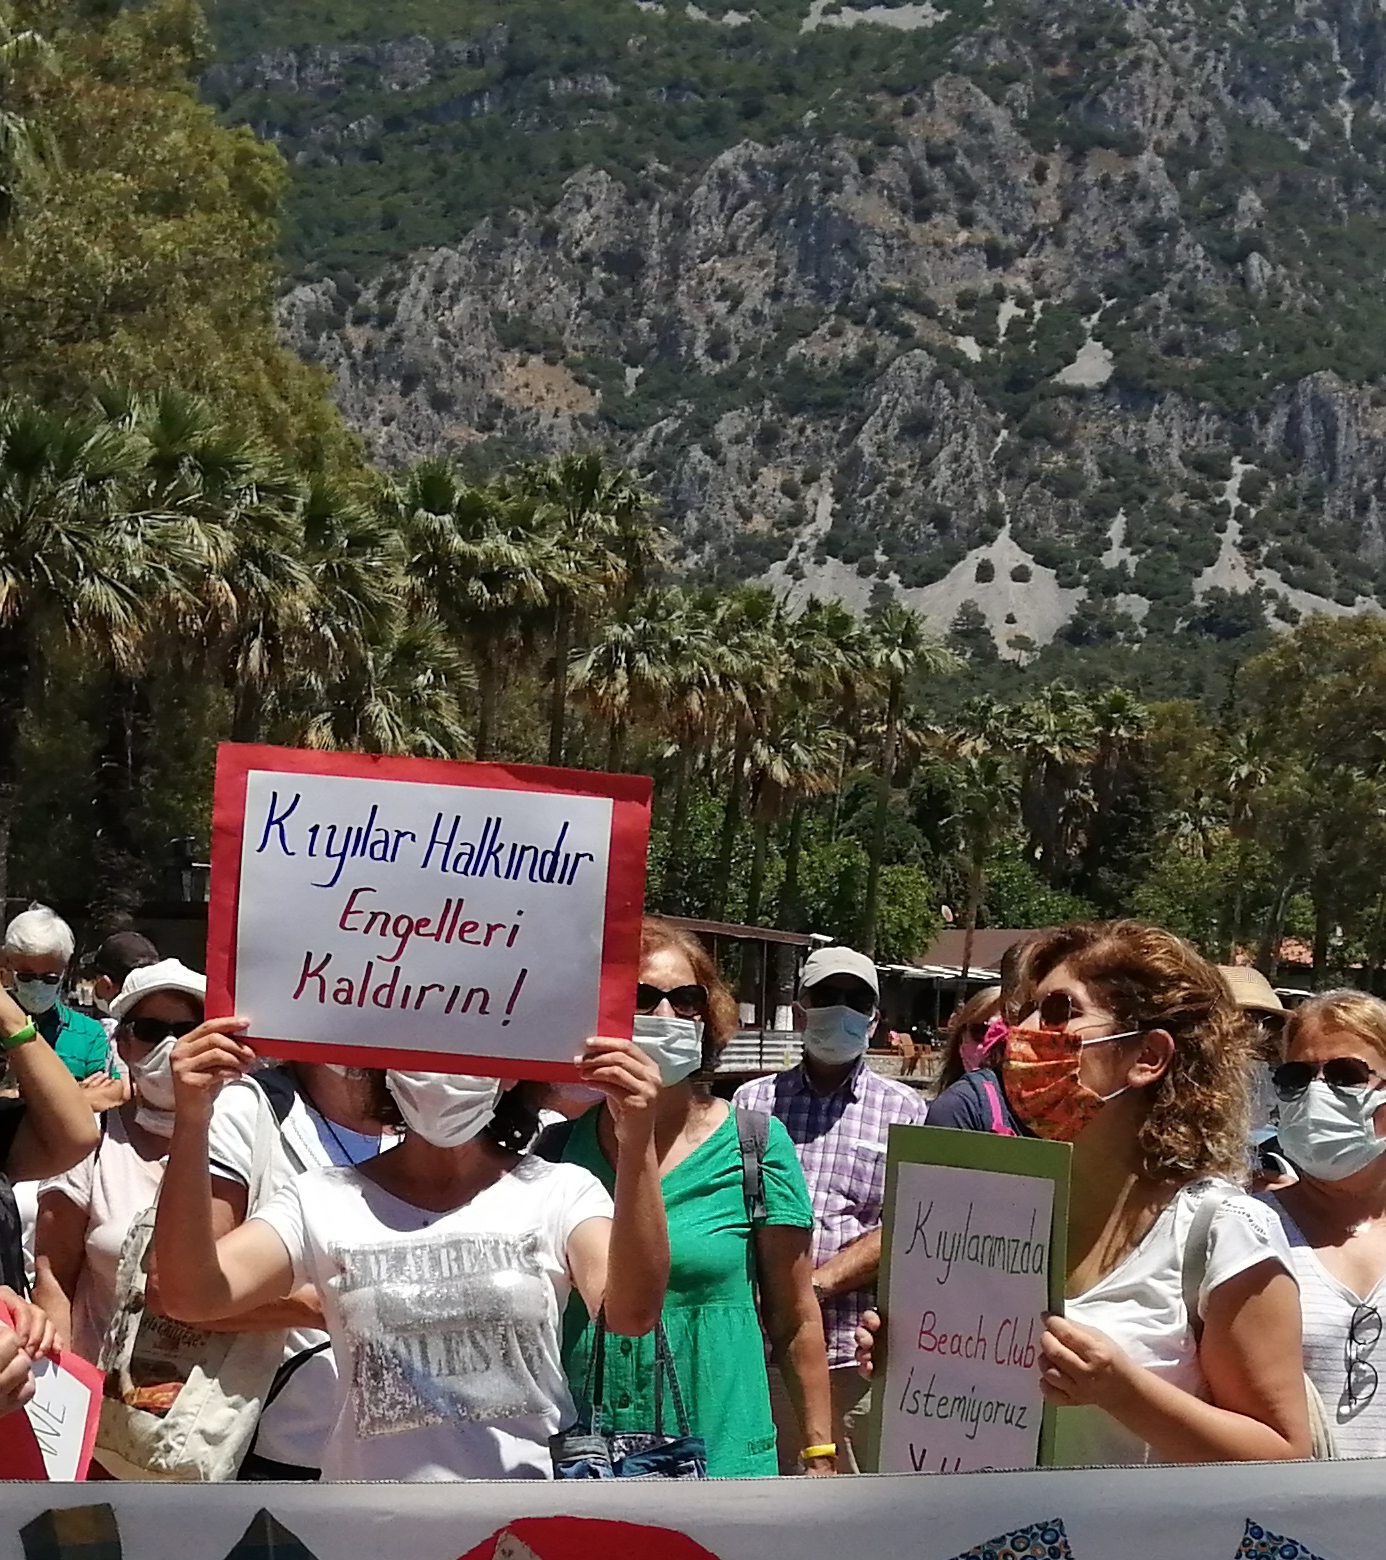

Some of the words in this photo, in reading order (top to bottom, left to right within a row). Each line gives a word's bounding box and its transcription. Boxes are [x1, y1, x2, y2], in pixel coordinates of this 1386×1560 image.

[254, 791, 417, 889] Kıyılar
[420, 812, 595, 886] Halkındır
[338, 887, 525, 963] Engelleri
[917, 1310, 988, 1361] Beach
[993, 1316, 1037, 1370] Club
